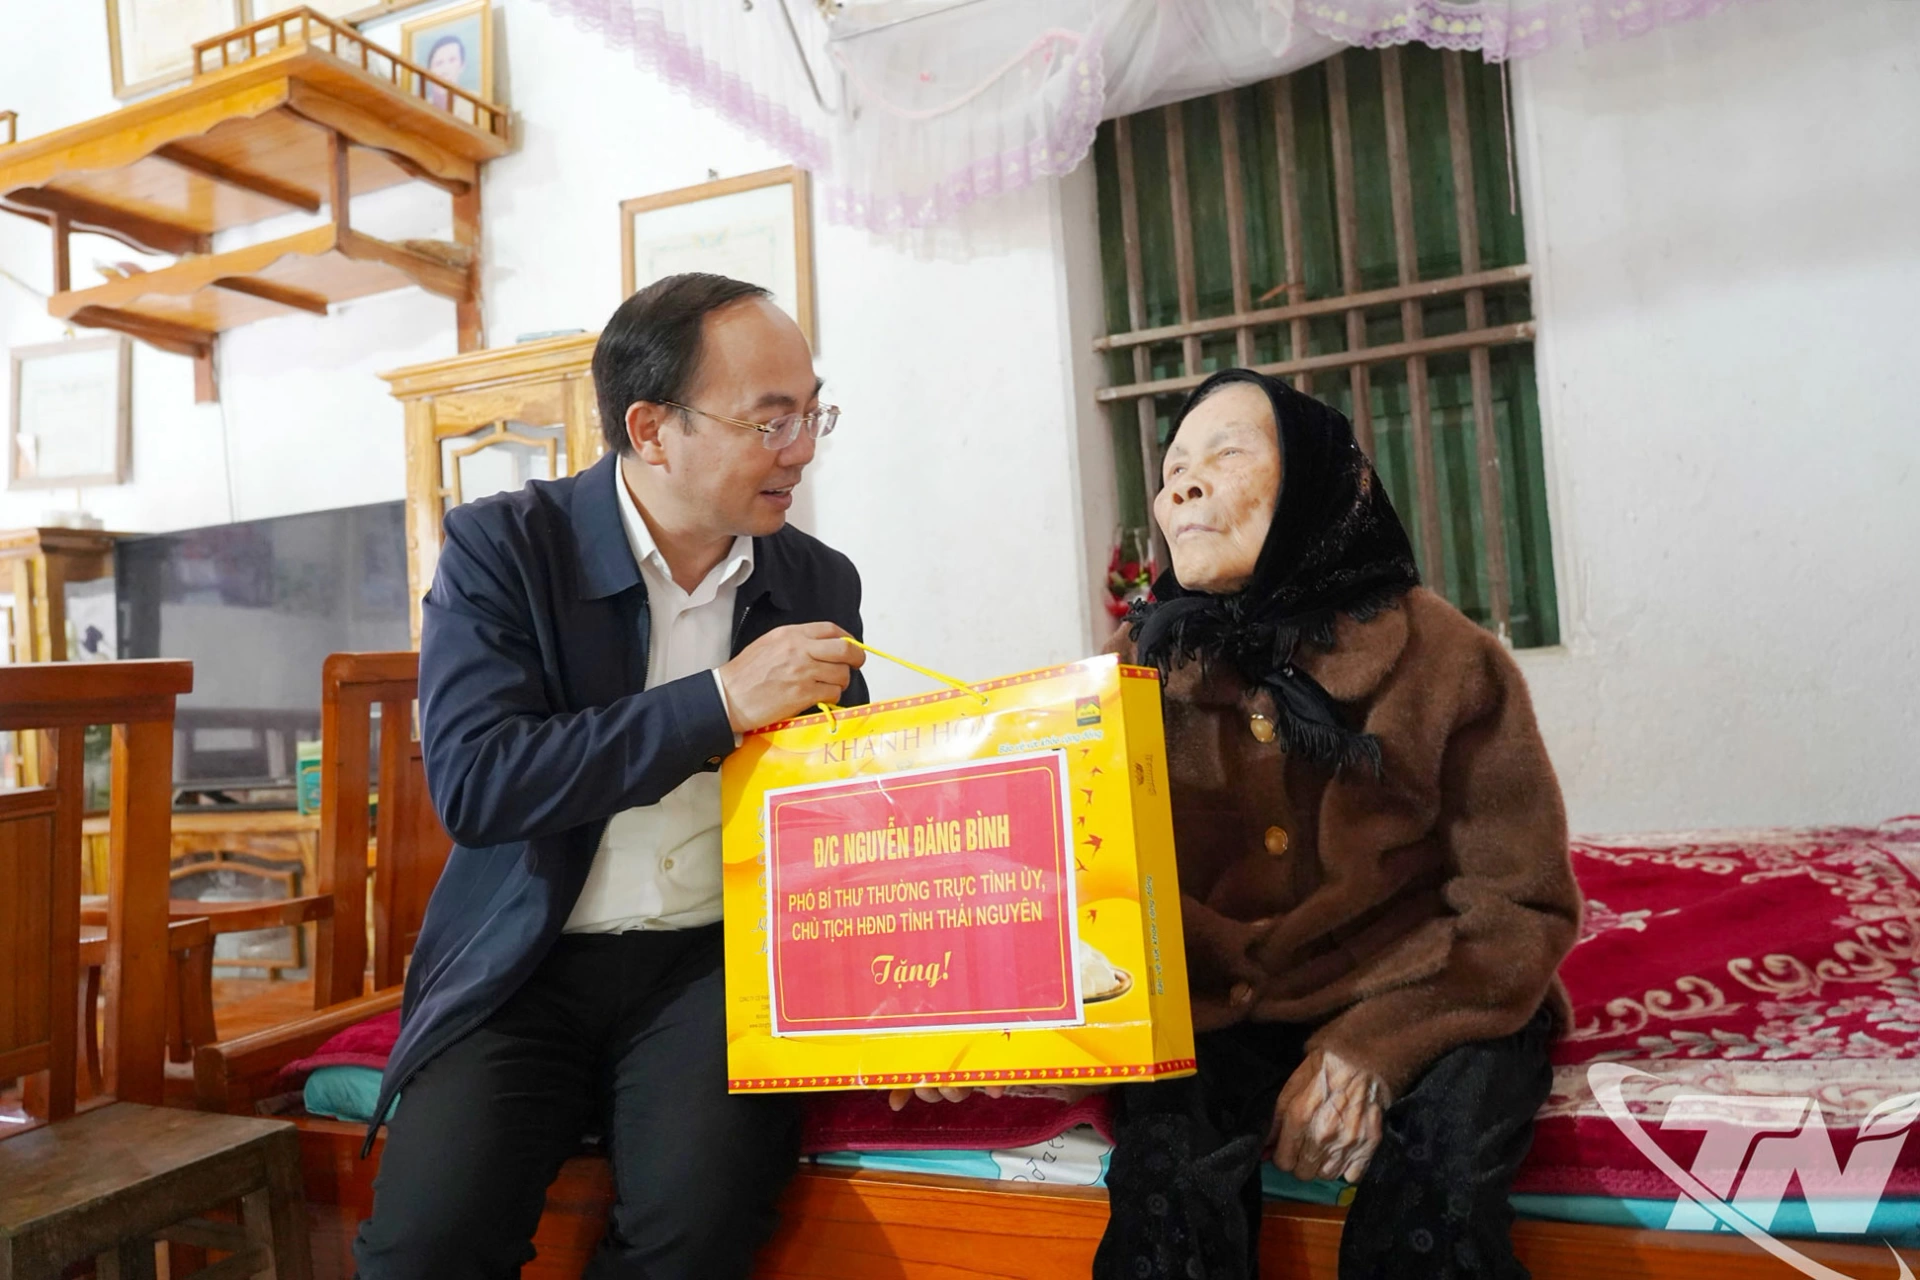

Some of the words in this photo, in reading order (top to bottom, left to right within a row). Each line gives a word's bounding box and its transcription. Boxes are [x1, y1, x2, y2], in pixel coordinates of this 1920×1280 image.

[814, 834, 840, 868] Đ/C
[843, 816, 910, 865] NGUYỄN
[913, 816, 961, 857] ĐĂNG
[965, 810, 1010, 851] BÌNH
[788, 888, 816, 912] PHÓ
[818, 885, 832, 910] BÍ
[834, 887, 864, 908] THƯ
[867, 879, 930, 905] THƯỜNG
[933, 875, 977, 901] TRỰC
[980, 869, 1017, 895] TỈNH
[1020, 865, 1046, 893] ỦY,
[792, 916, 819, 941] CHỦ
[822, 918, 853, 943] TỊCH
[857, 914, 896, 935] HĐND
[900, 908, 934, 932] TỈNH
[937, 903, 973, 928] THÁI
[976, 897, 1043, 926] NGUYÊN
[871, 951, 952, 989] Tặng!
